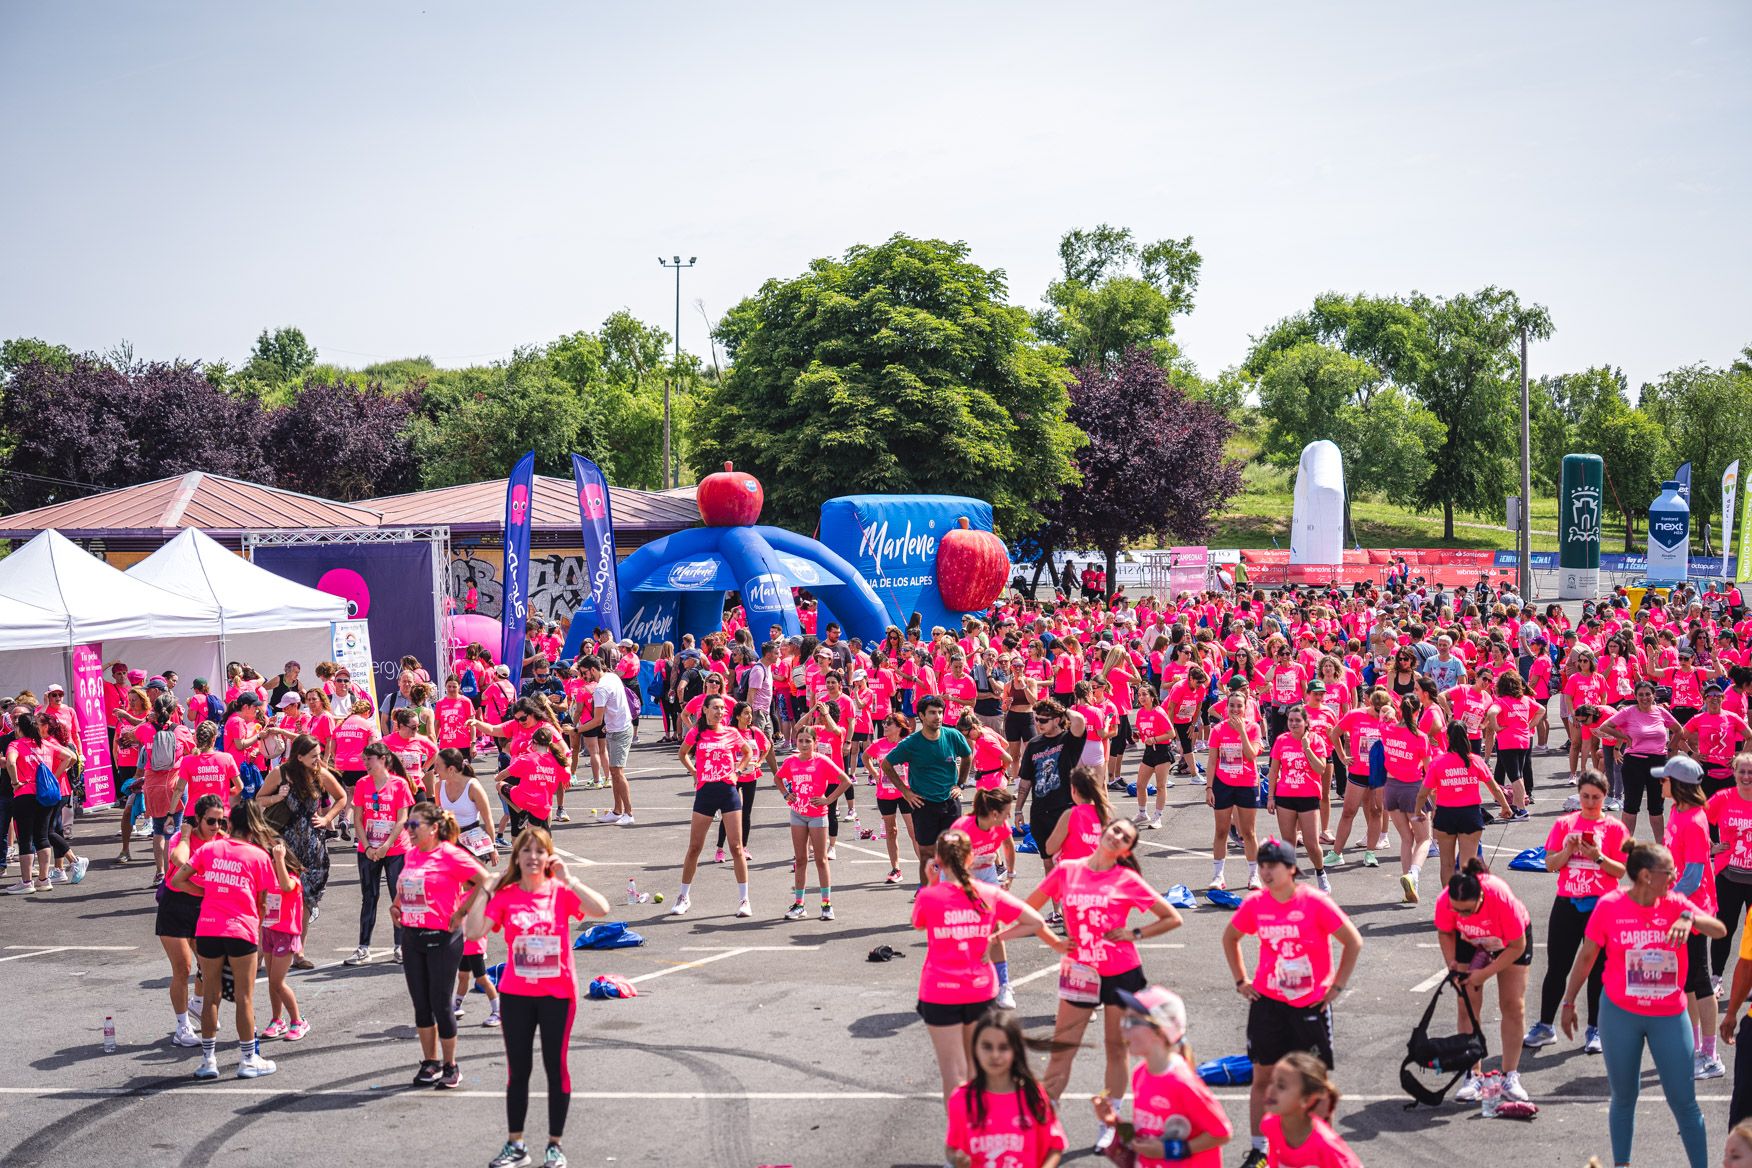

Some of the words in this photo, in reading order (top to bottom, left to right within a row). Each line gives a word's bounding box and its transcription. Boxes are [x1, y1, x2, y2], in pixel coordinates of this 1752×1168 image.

[1655, 522, 1683, 530] next
[859, 520, 935, 575] Marlene
[673, 566, 713, 581] Marlene
[880, 578, 891, 588] DE
[893, 577, 908, 587] LOS
[910, 576, 932, 586] ALPES
[1386, 738, 1407, 749] SOMOS
[197, 766, 219, 774] SOMOS
[1445, 767, 1468, 777] SOMOS
[529, 774, 556, 784] IMPARABLE
[365, 802, 391, 811] CAERA
[212, 858, 242, 873] SOMOS
[1565, 880, 1591, 893] MUJER
[1066, 894, 1108, 908] CARRERA
[944, 909, 981, 925] SOMOS
[1089, 909, 1101, 927] DE
[1259, 925, 1300, 939] CARRERA
[1620, 930, 1667, 944] CARRERA
[1078, 947, 1108, 962] MUJER
